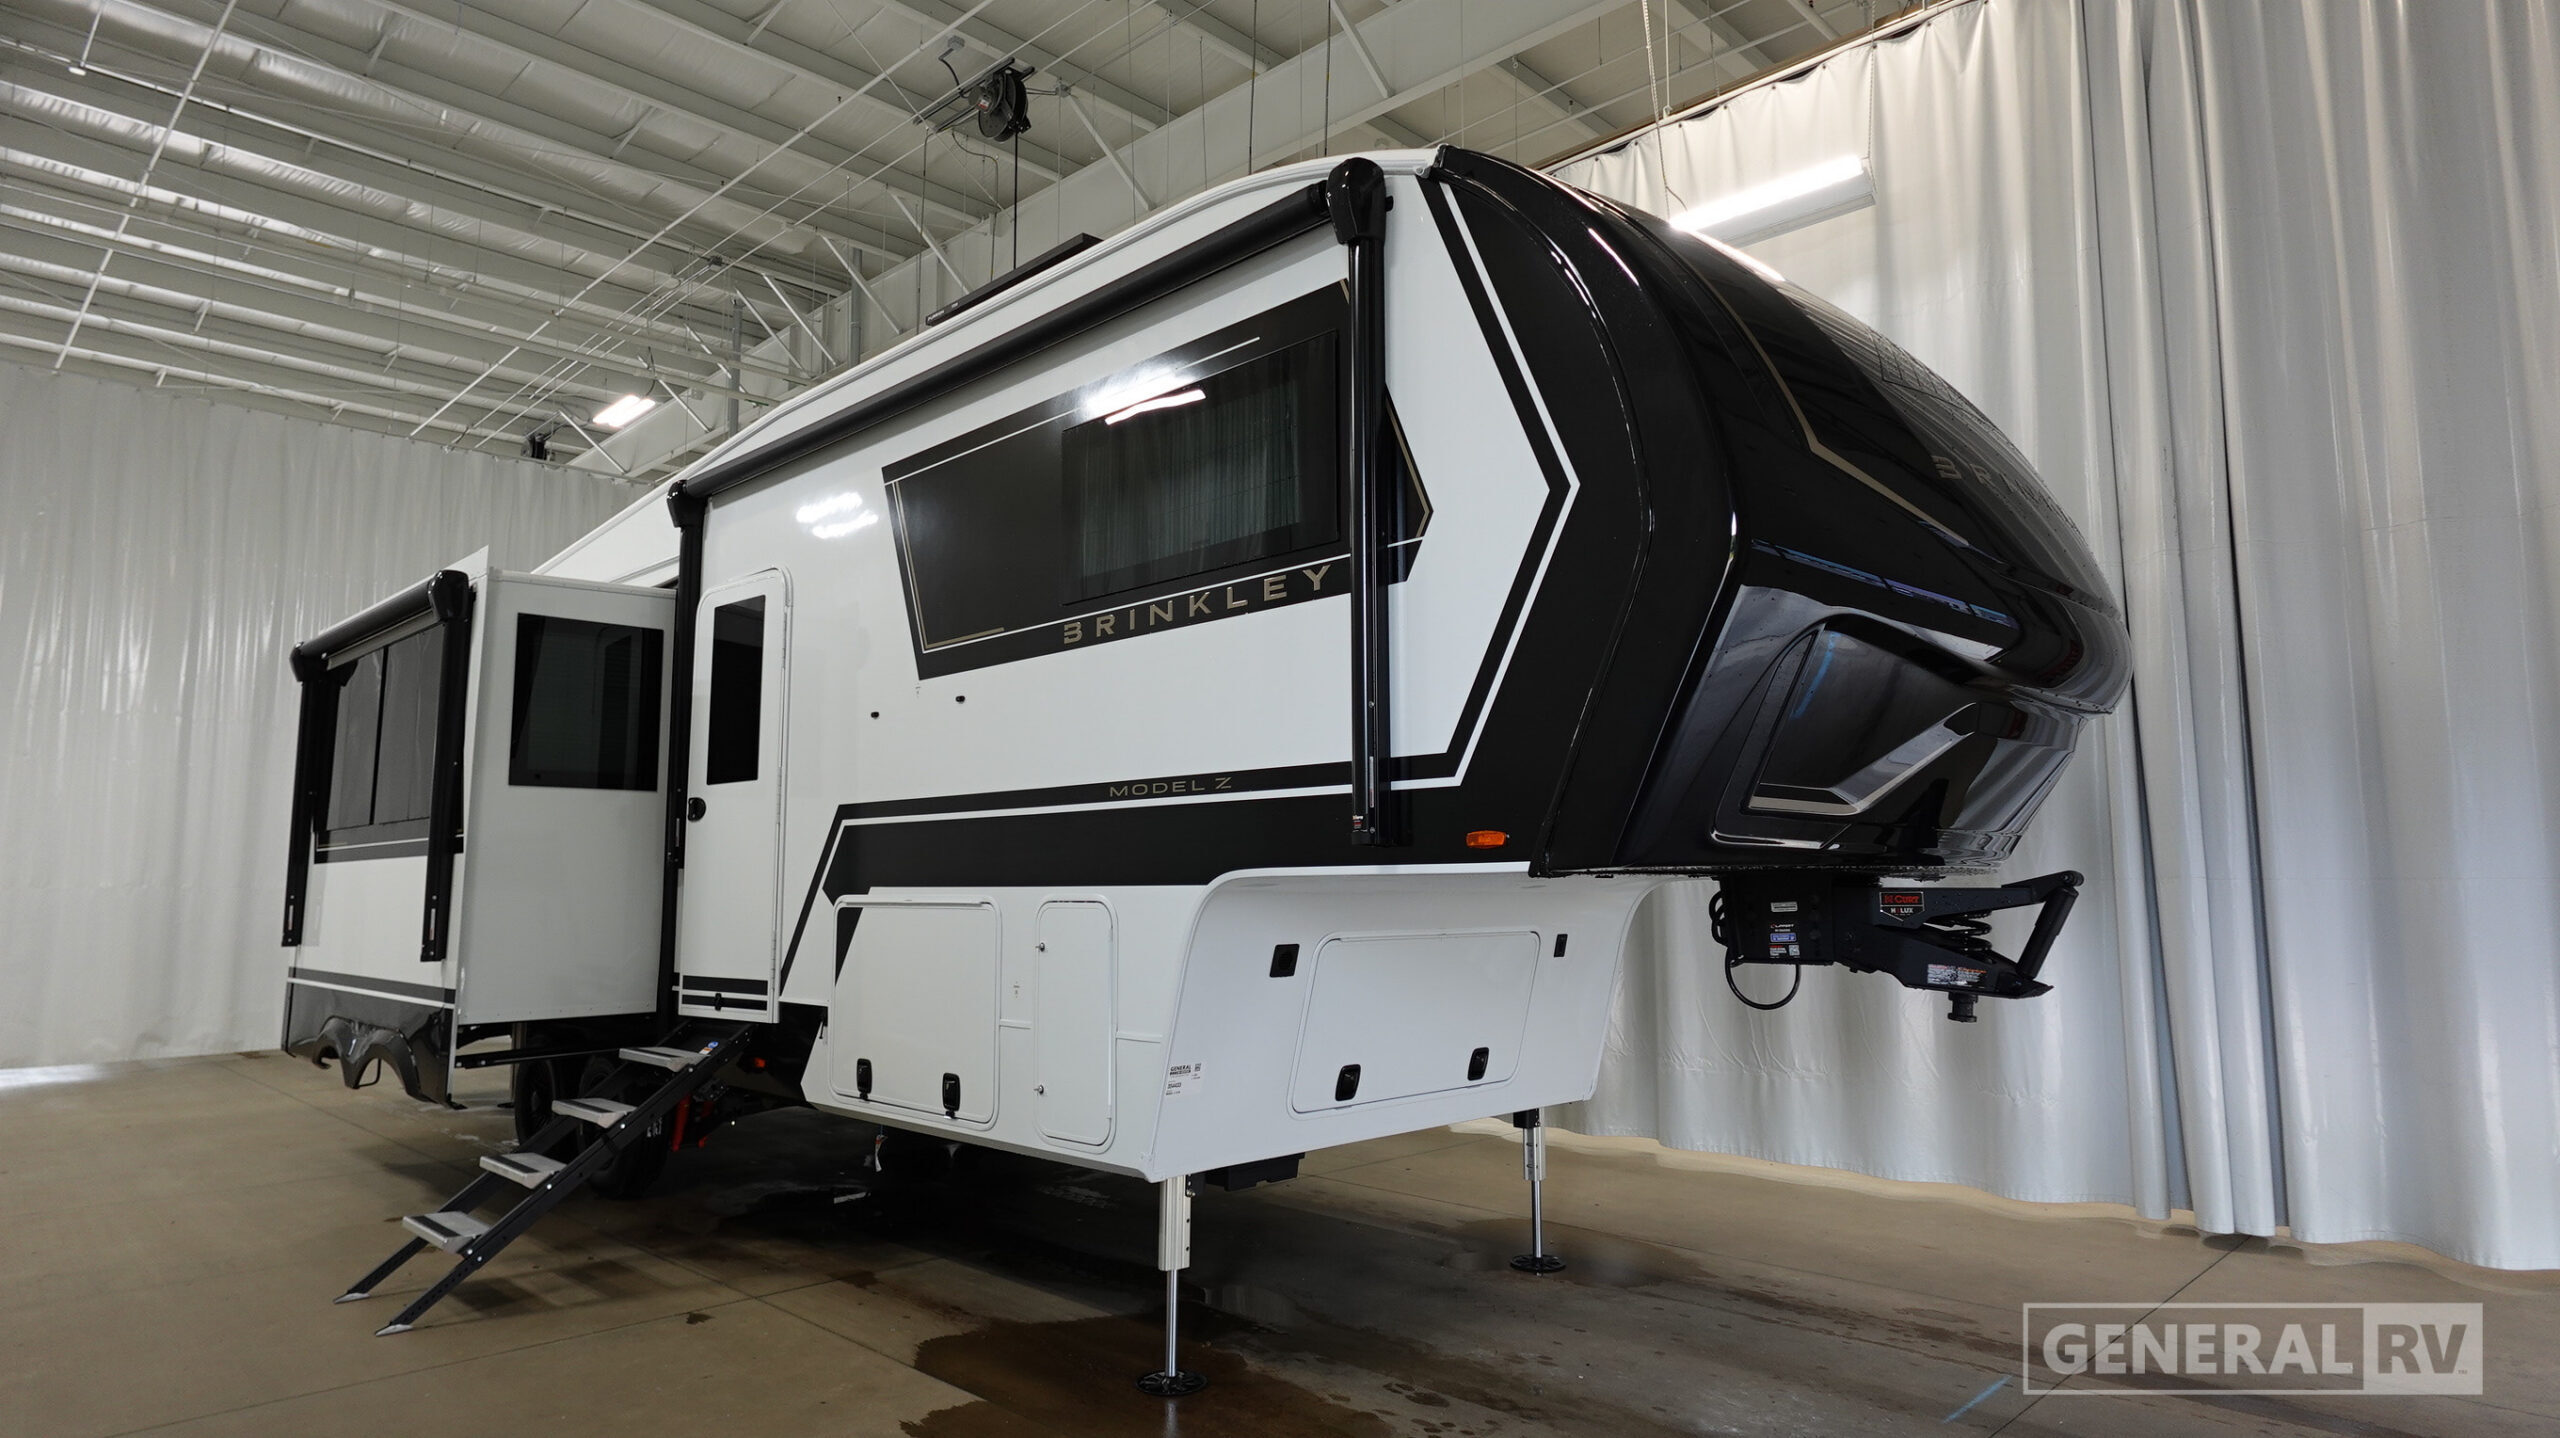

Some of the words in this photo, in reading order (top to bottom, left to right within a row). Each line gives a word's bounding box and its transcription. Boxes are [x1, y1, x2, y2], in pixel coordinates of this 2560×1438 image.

[1063, 564, 1331, 645] BRINKLEY
[1109, 779, 1206, 798] MODEL
[1215, 776, 1233, 790] Z
